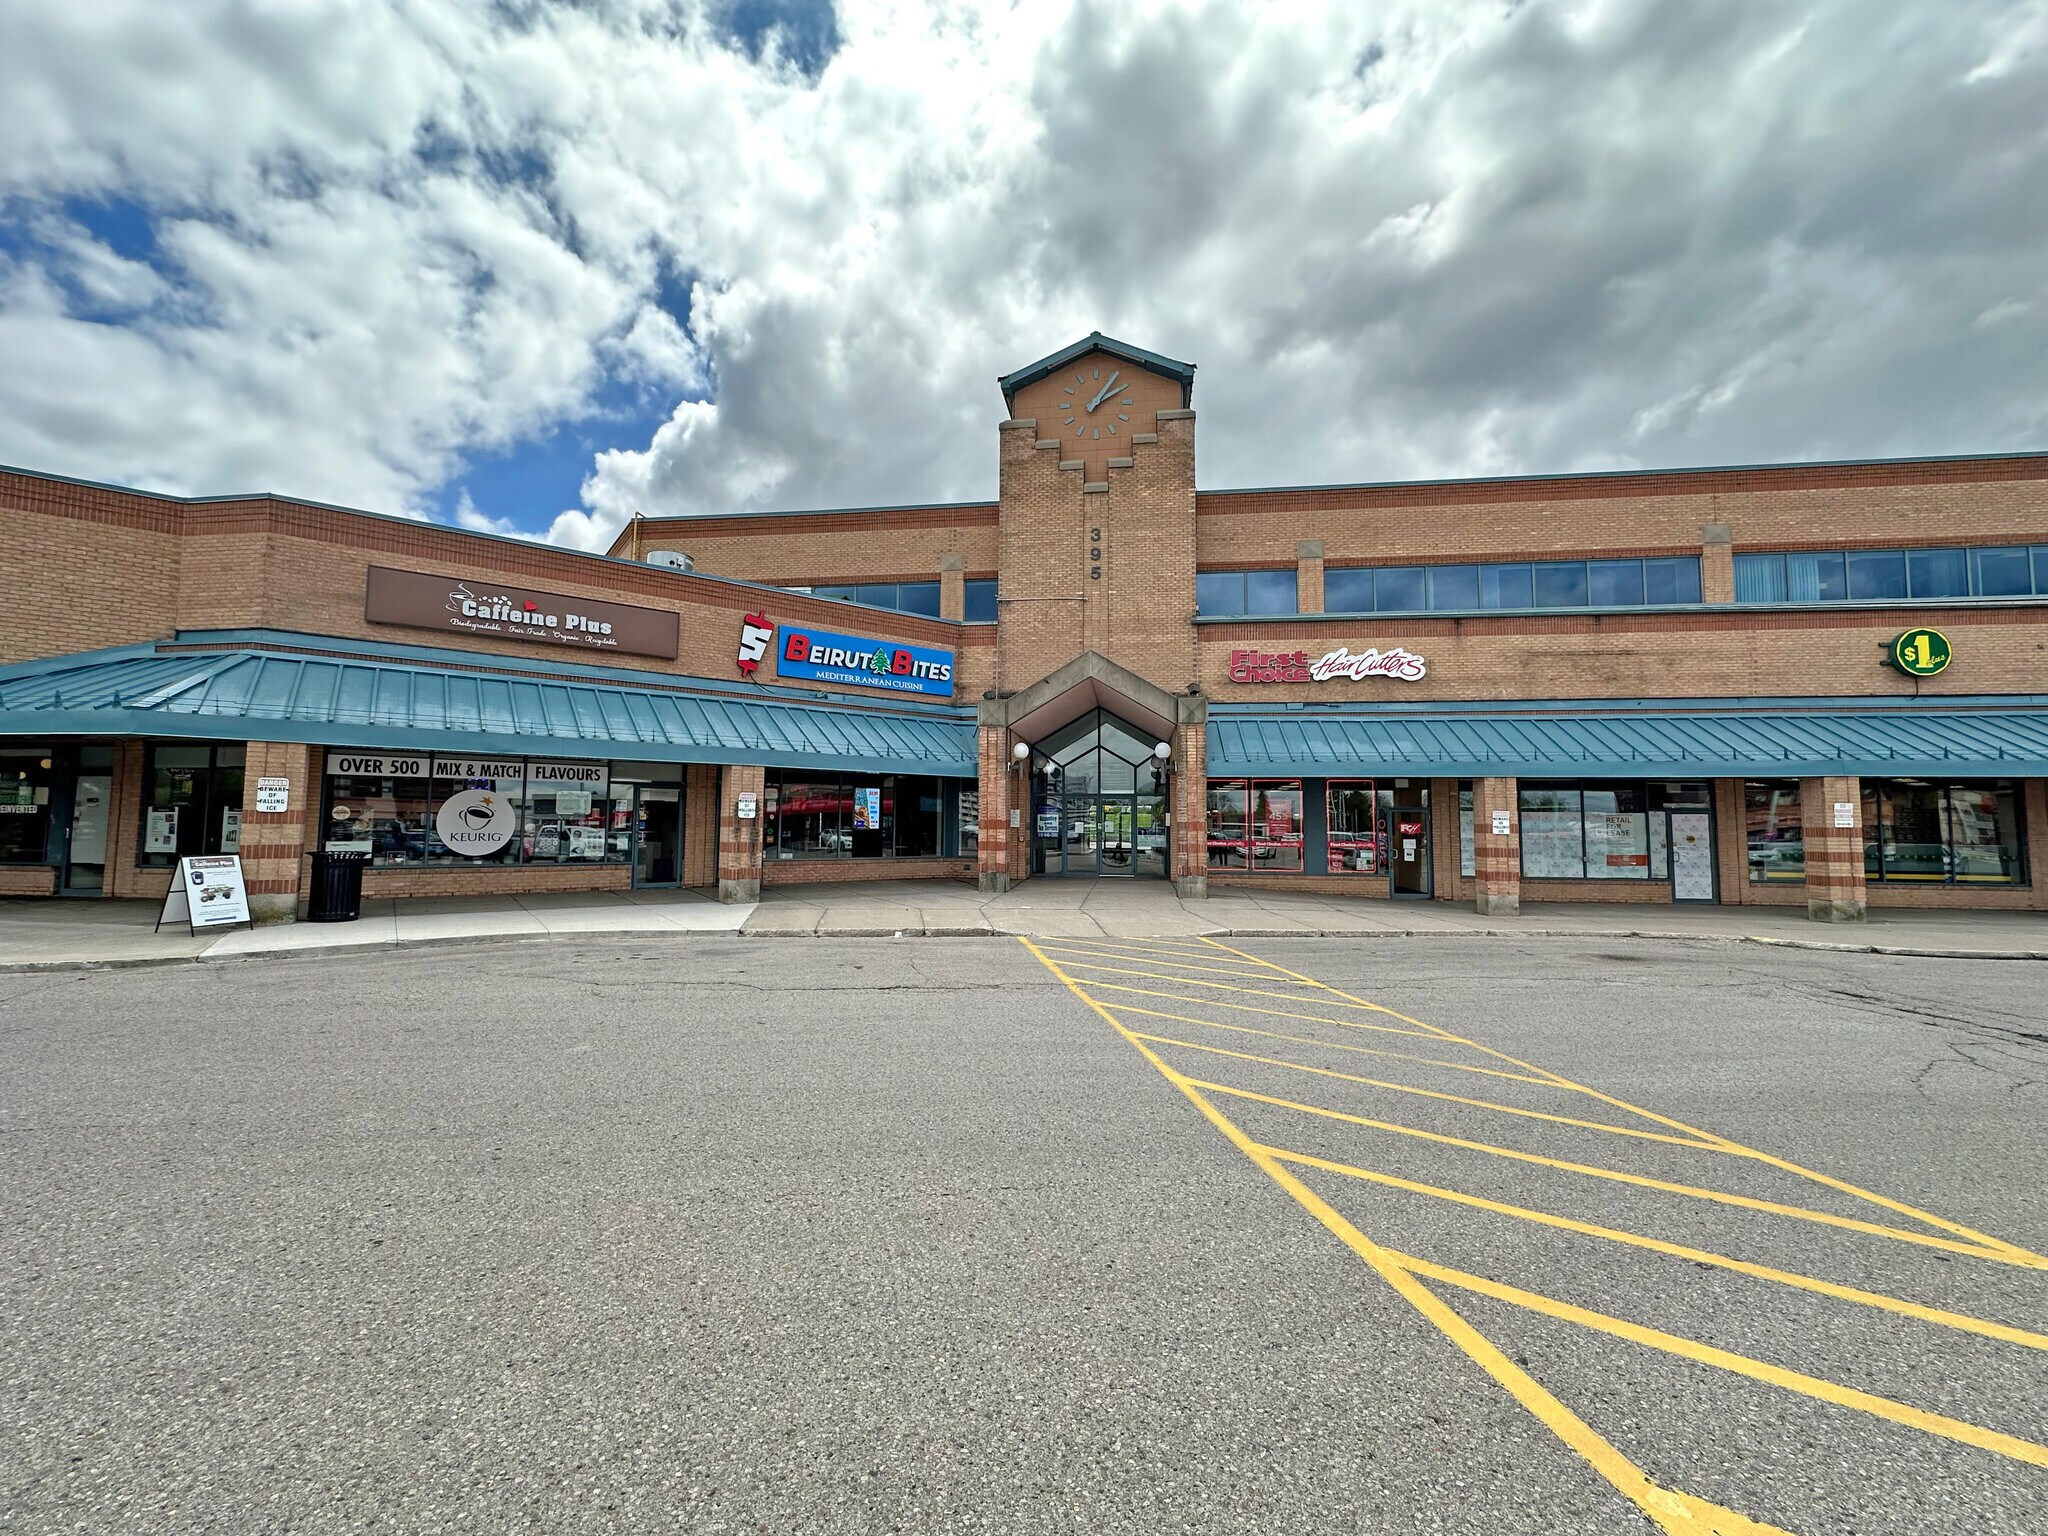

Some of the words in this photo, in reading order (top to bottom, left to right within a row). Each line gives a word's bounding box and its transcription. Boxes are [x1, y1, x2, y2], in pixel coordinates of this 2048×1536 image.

[1090, 528, 1102, 580] 395
[462, 599, 558, 628] Caffeine
[565, 614, 612, 635] Plus
[449, 618, 502, 631] Biodegradable
[508, 625, 524, 634] Fair
[526, 627, 547, 637] Trade
[552, 630, 580, 642] Organic
[785, 634, 873, 670] BEIRUT
[892, 650, 951, 681] BITES
[1231, 650, 1308, 667] First
[816, 671, 892, 687] MEDITERRANEAN
[893, 681, 924, 691] CUISINE
[1229, 665, 1311, 682] Choice
[339, 758, 383, 773] OVER
[390, 760, 420, 775] 500
[436, 763, 461, 776] MIX
[466, 764, 475, 776] &
[480, 766, 521, 778] MATCH
[535, 766, 600, 781] FLAVOURS
[450, 832, 501, 842] KEURIG
